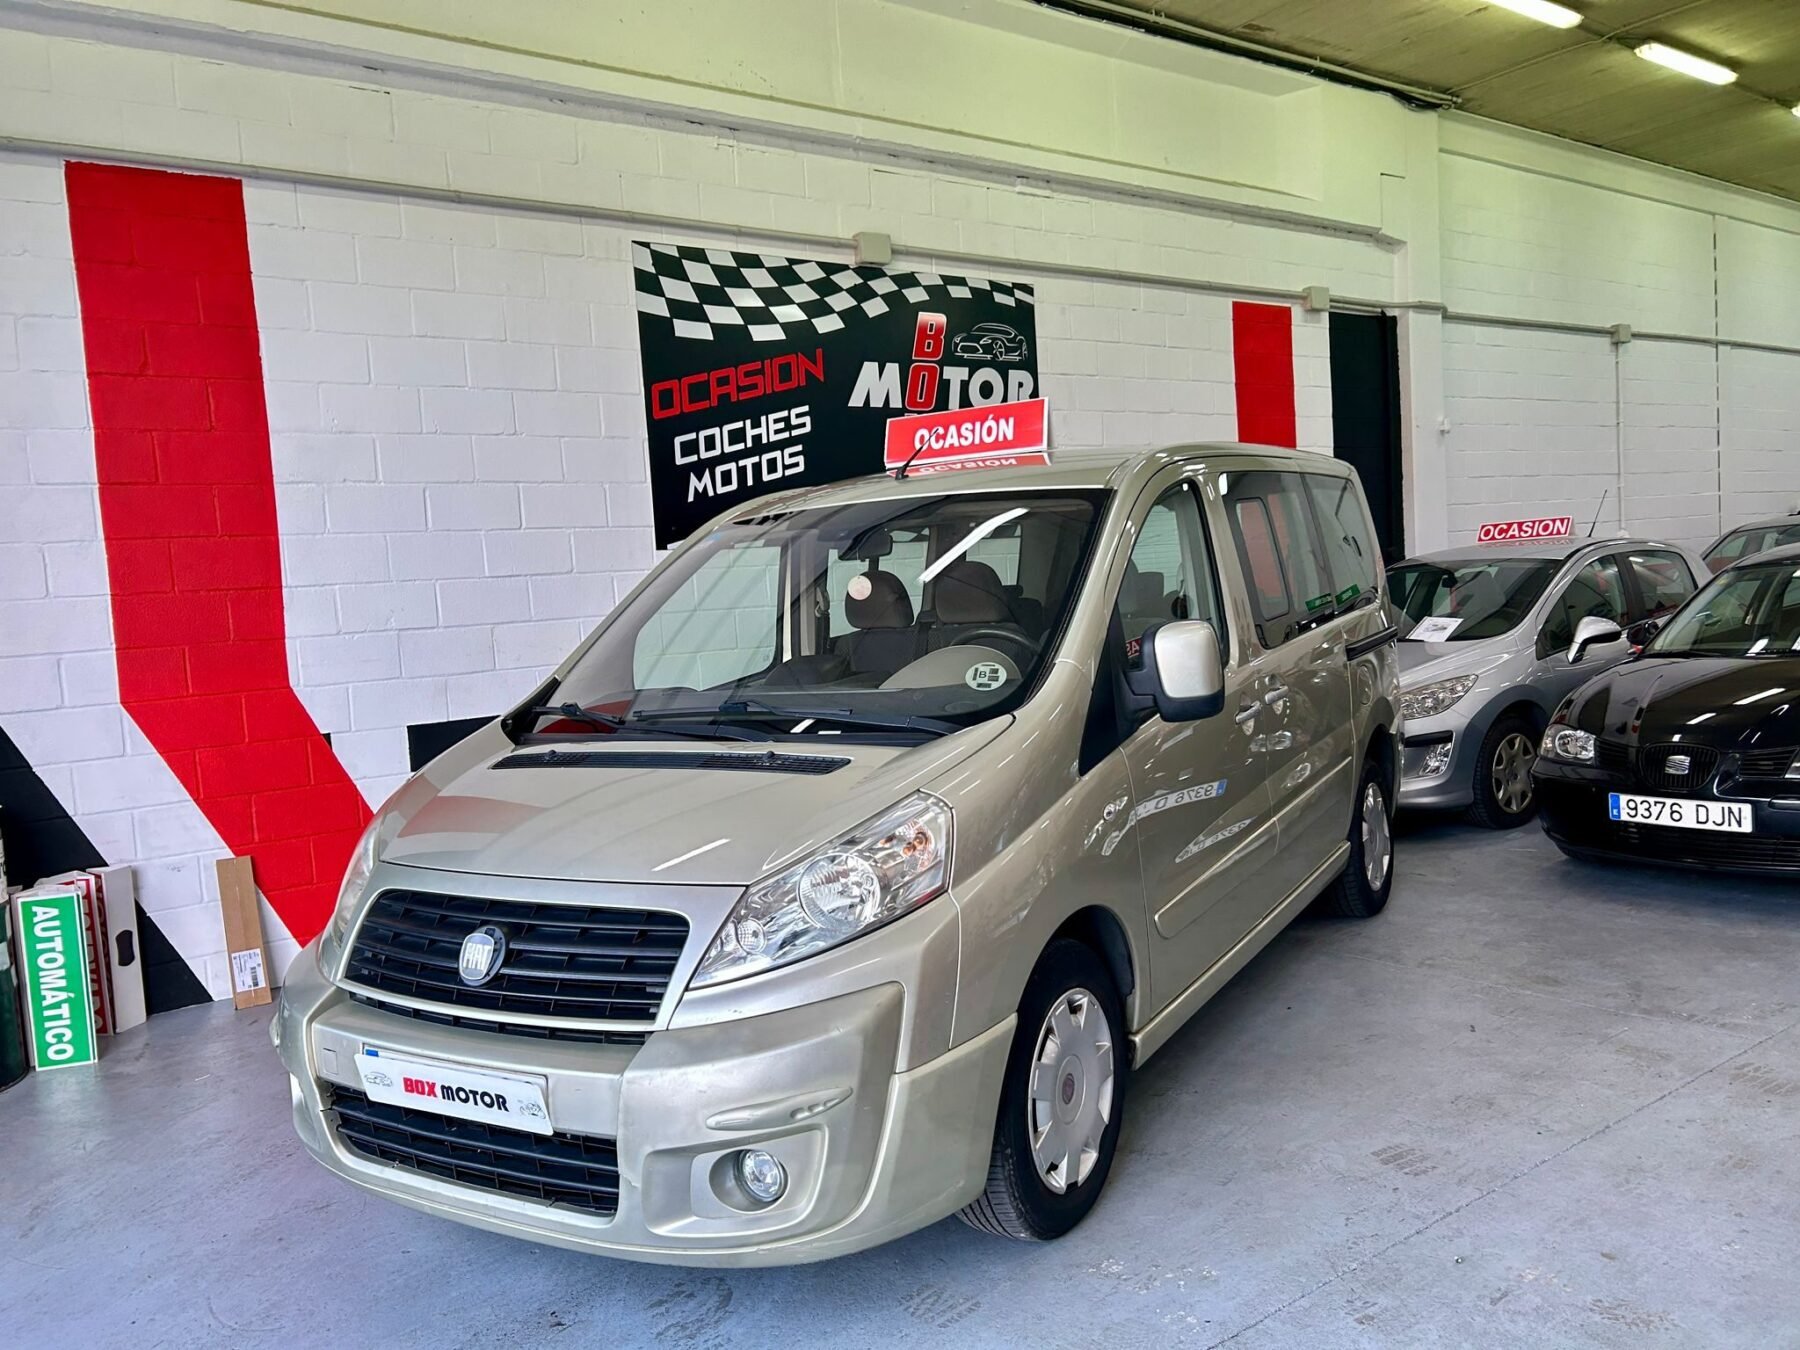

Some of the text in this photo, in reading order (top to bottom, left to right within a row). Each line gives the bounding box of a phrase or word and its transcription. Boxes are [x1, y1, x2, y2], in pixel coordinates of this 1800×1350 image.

[651, 348, 825, 420] OCASION
[673, 405, 812, 466] COCHES
[914, 414, 1015, 451] OCASIÓN
[687, 444, 805, 503] MOTOS
[1480, 519, 1569, 540] OCASION
[1626, 798, 1683, 823] 9376
[1695, 803, 1742, 828] DJN
[463, 942, 492, 971] FIAT
[31, 905, 75, 1061] AUTOMÁTICO
[403, 1077, 510, 1112] BOX MOTOR
